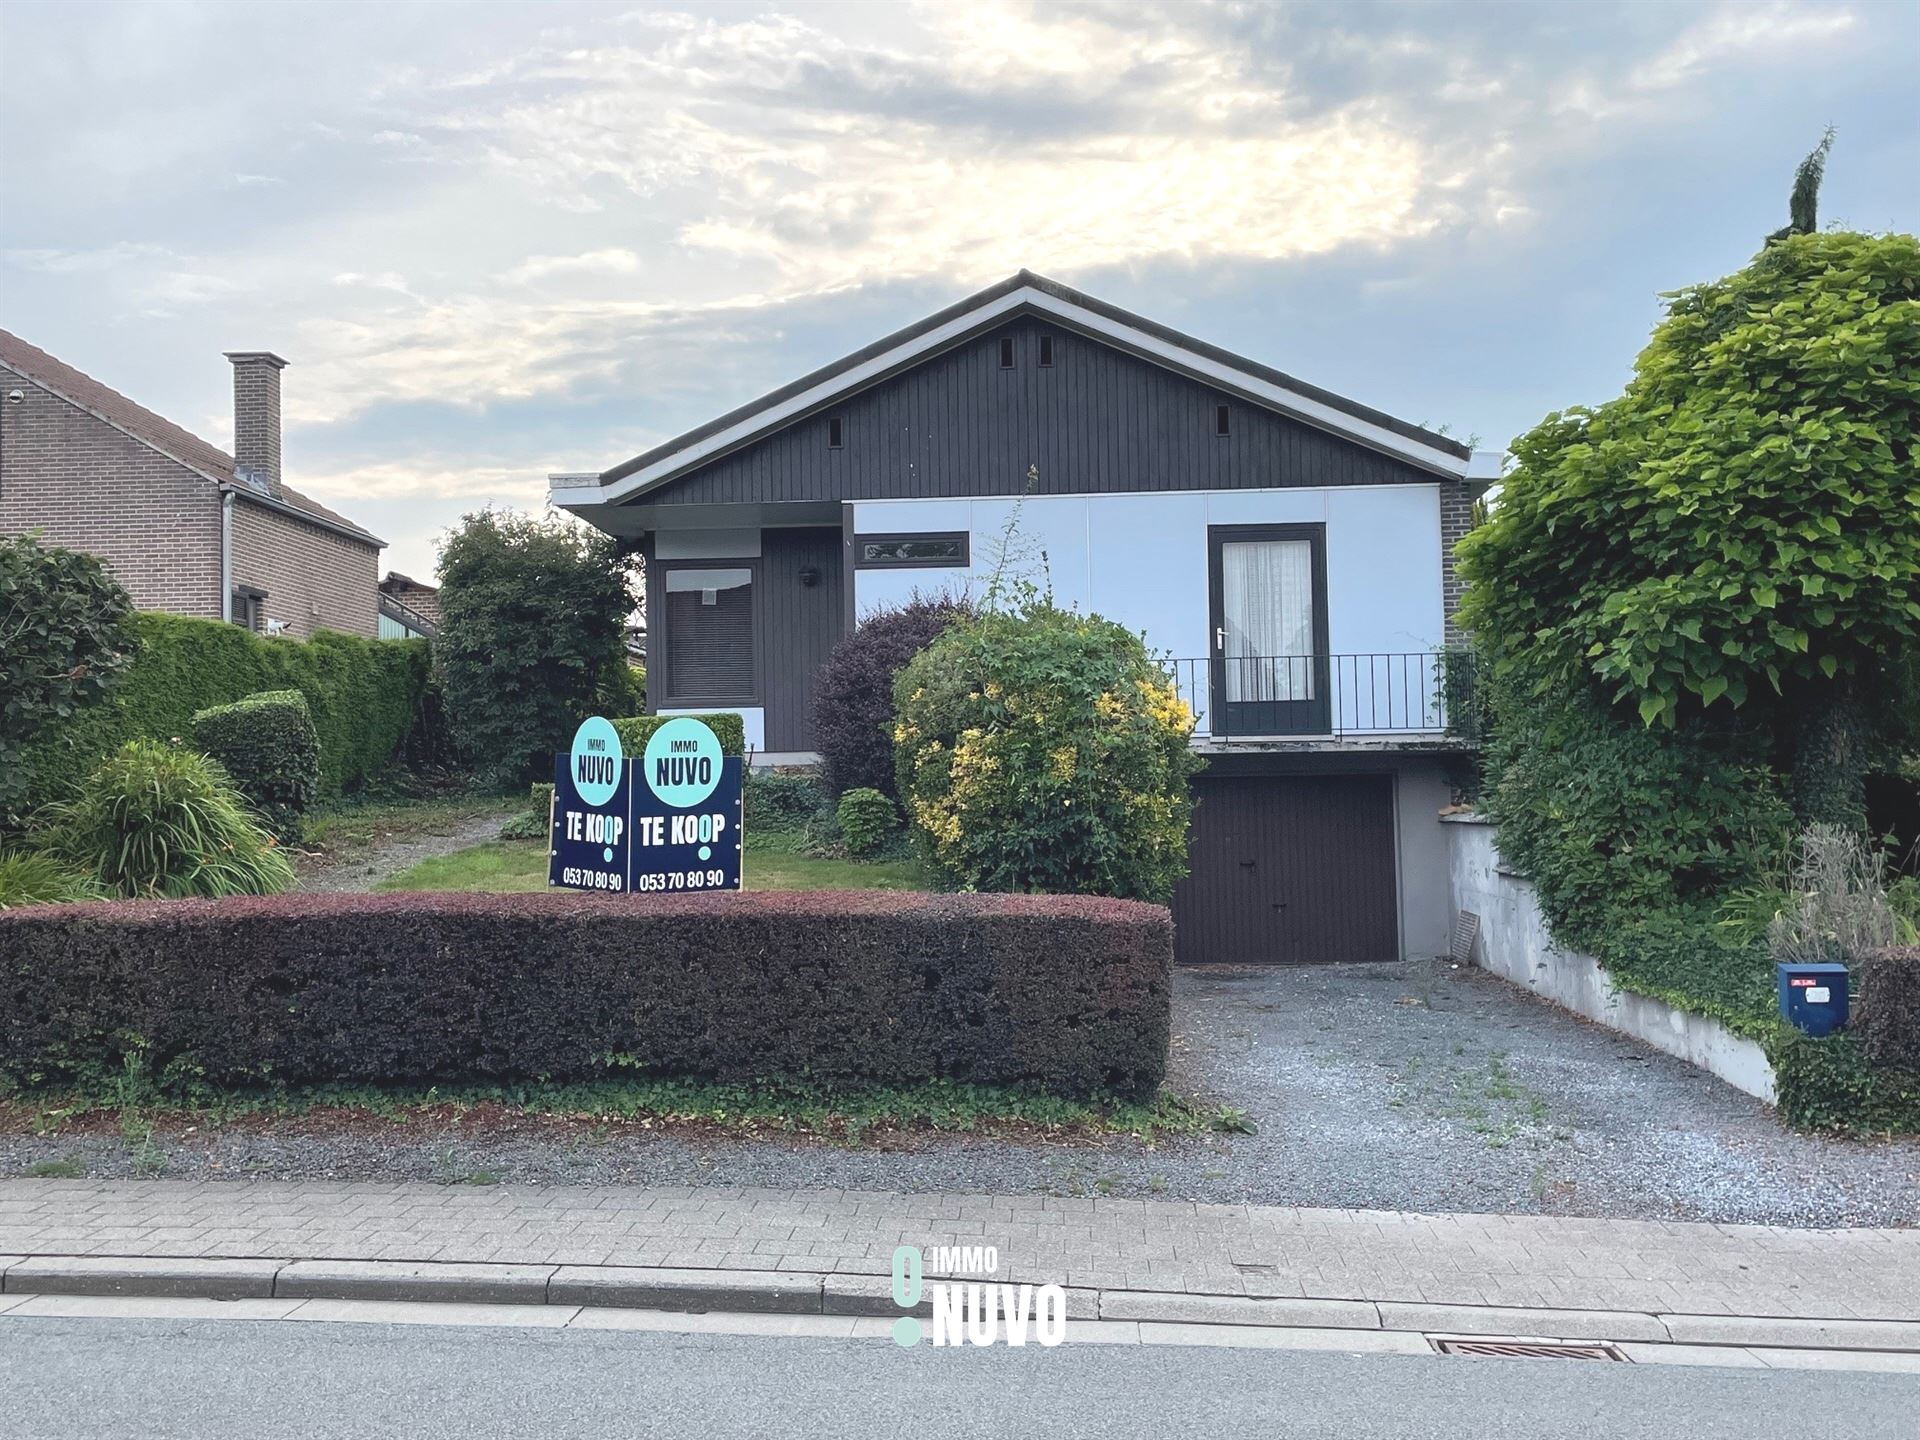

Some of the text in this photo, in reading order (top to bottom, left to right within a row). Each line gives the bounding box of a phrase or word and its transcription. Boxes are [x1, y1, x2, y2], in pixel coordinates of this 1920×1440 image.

[587, 738, 606, 752] IMMO
[670, 740, 698, 753] IMMO
[577, 754, 615, 786] NUVO
[656, 756, 712, 787] NUVO
[566, 811, 624, 846] TE KOOP
[639, 813, 726, 847] TE KOOP
[563, 867, 622, 891] 053 70 80 90
[639, 869, 724, 892] 053 70 80 90
